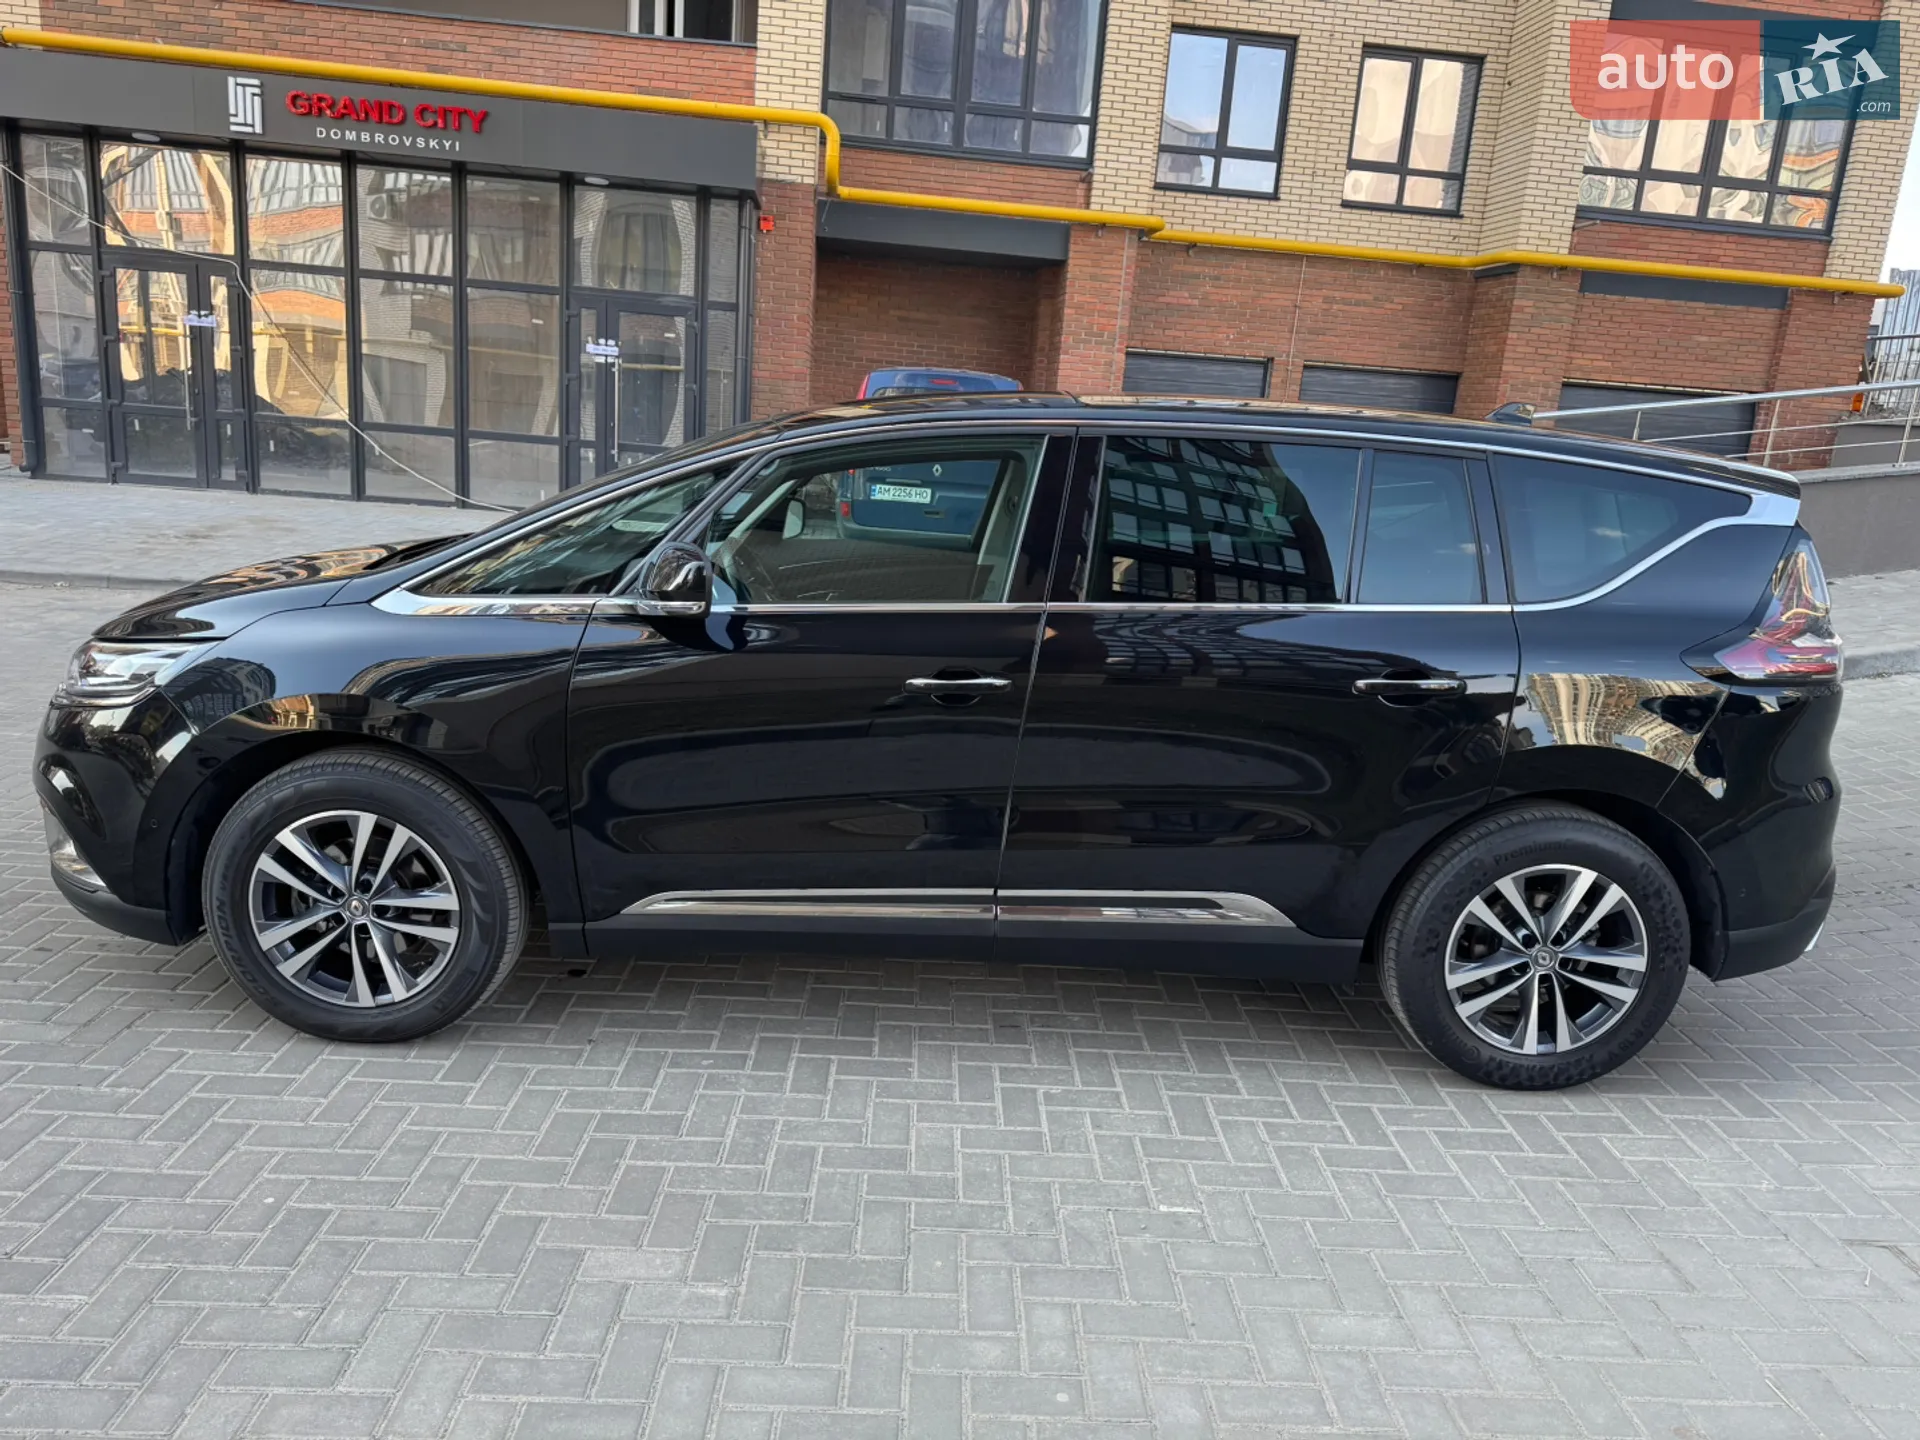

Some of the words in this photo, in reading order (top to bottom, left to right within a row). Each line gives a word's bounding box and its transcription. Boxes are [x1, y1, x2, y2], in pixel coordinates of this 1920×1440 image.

[285, 89, 406, 125] GRAND
[413, 103, 489, 133] CITY
[316, 127, 461, 152] DOMBROVSKYI
[877, 486, 891, 497] AM
[892, 487, 913, 499] 2256
[914, 490, 928, 500] HO
